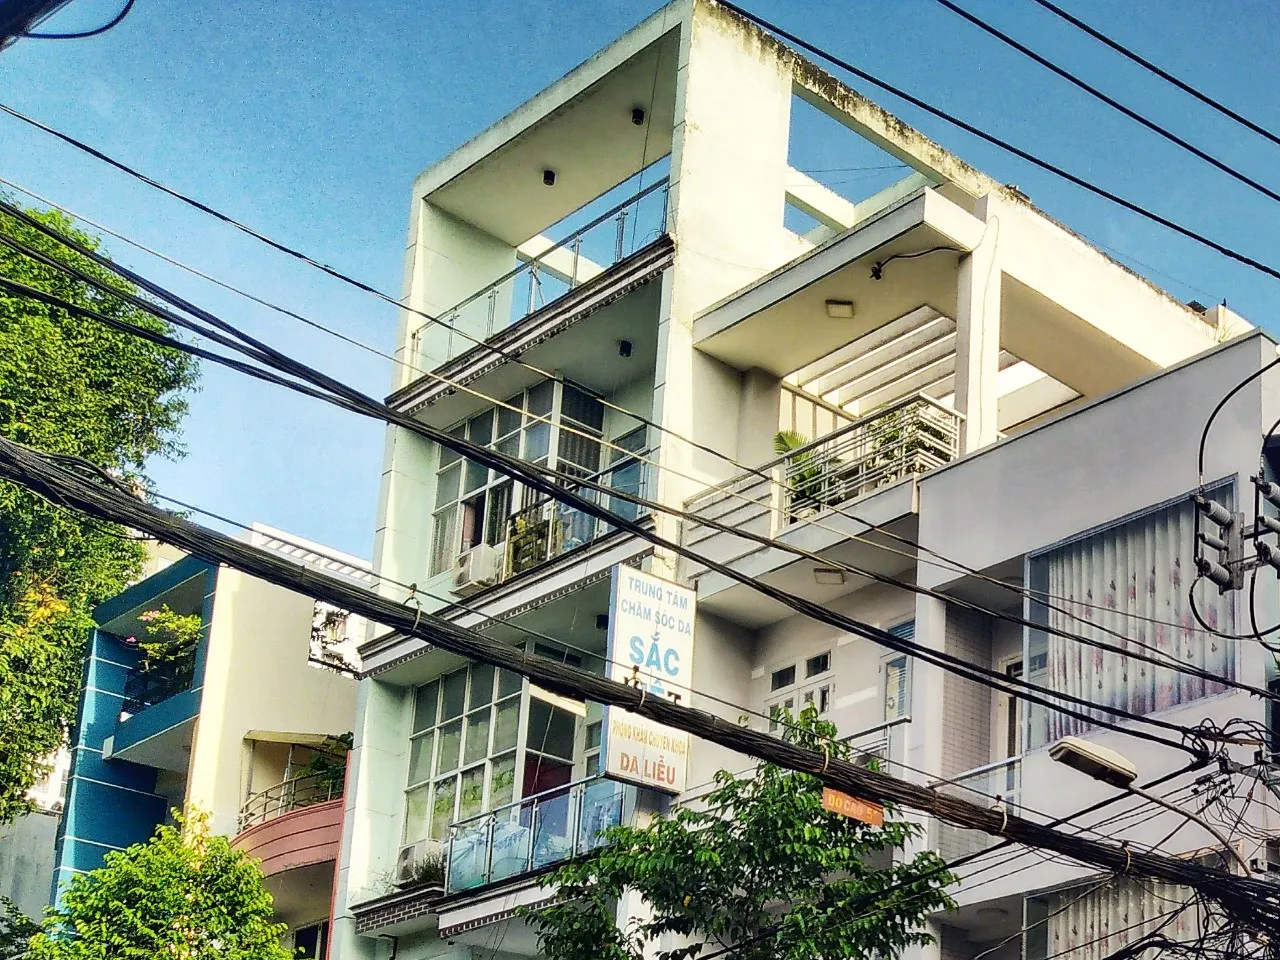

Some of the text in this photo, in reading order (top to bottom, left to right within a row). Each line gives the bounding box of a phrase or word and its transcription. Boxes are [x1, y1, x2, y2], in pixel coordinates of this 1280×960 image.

[627, 576, 688, 611] TRUNG TÂM
[621, 598, 692, 636] CHĂM SÓC DA
[628, 631, 680, 677] SẮC
[620, 751, 676, 785] DA LIỄU
